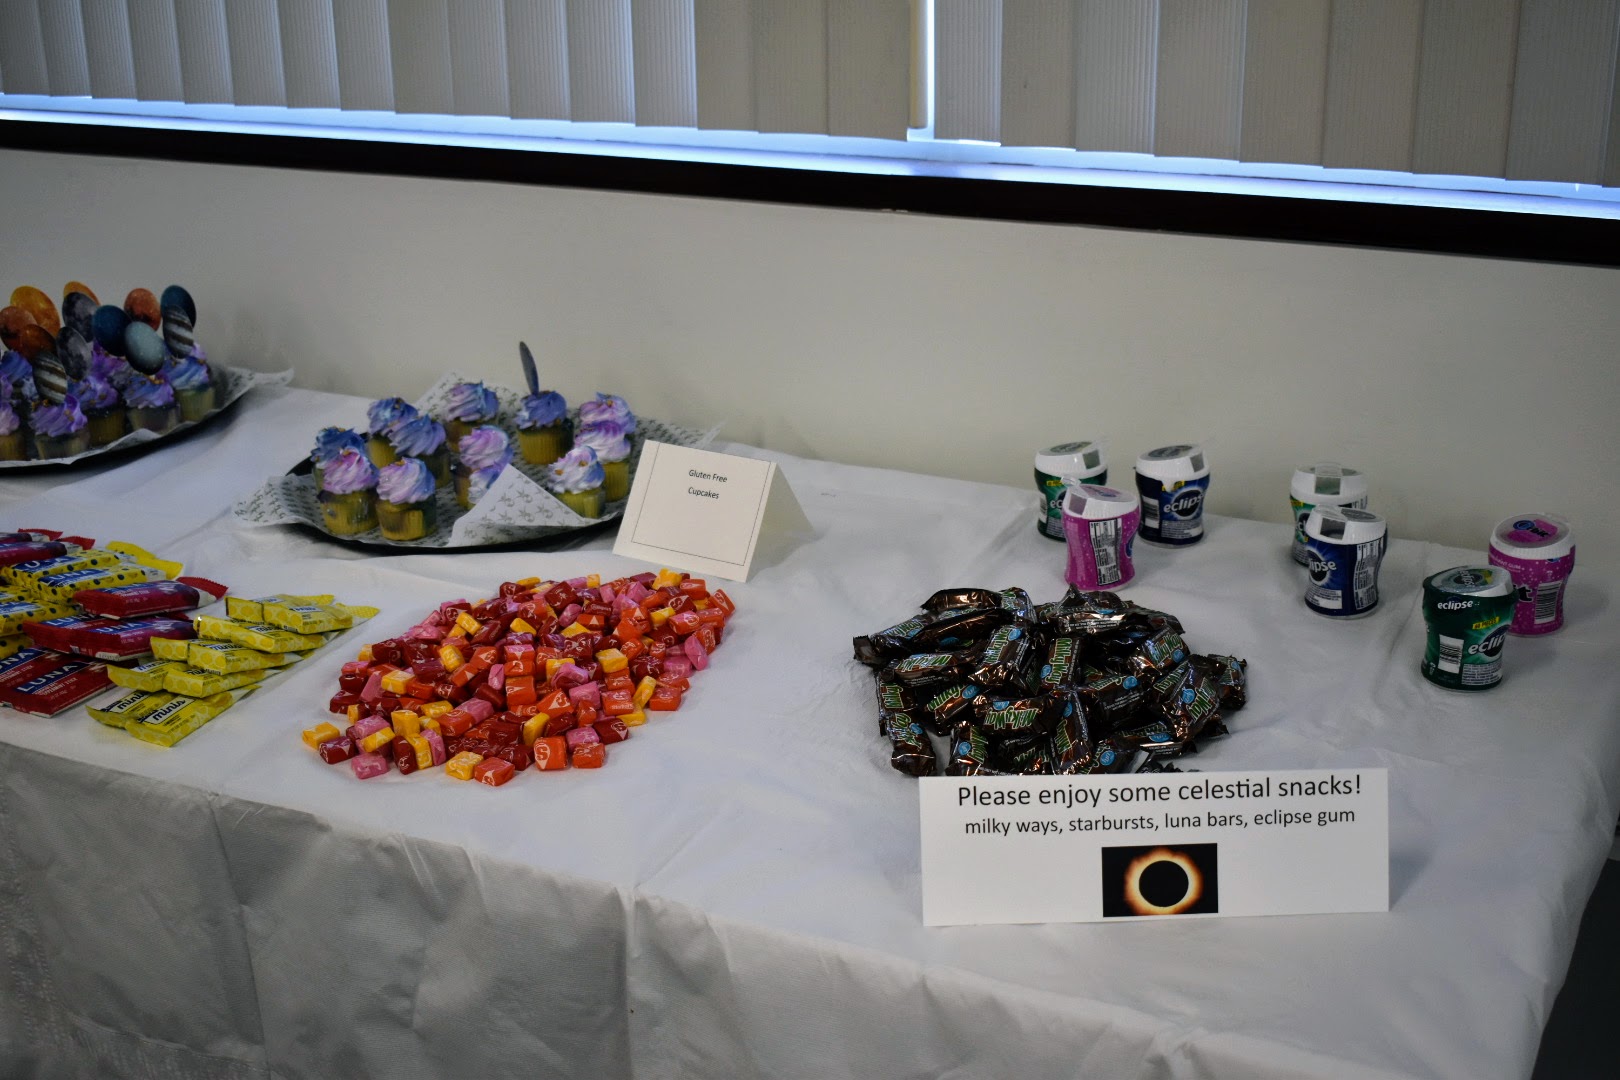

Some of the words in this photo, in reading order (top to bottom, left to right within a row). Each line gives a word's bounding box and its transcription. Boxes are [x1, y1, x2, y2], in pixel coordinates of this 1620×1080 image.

[688, 469, 711, 481] Gluten
[712, 473, 728, 483] Free
[687, 486, 720, 500] Cupcakes
[1437, 600, 1474, 610] eclipse
[16, 664, 78, 692] LUNA
[152, 700, 186, 721] minis
[958, 786, 1031, 806] Please
[1038, 784, 1101, 808] enjoy
[1108, 786, 1171, 803] some
[1178, 777, 1270, 800] celestial
[1278, 774, 1361, 797] snacks!
[965, 818, 1011, 836] milky
[1016, 819, 1063, 835] ways,
[1068, 815, 1159, 834] starbursts,
[1165, 813, 1201, 829] luna
[1207, 811, 1248, 828] bars,
[1253, 809, 1312, 828] eclipse
[1317, 810, 1355, 826] gum
